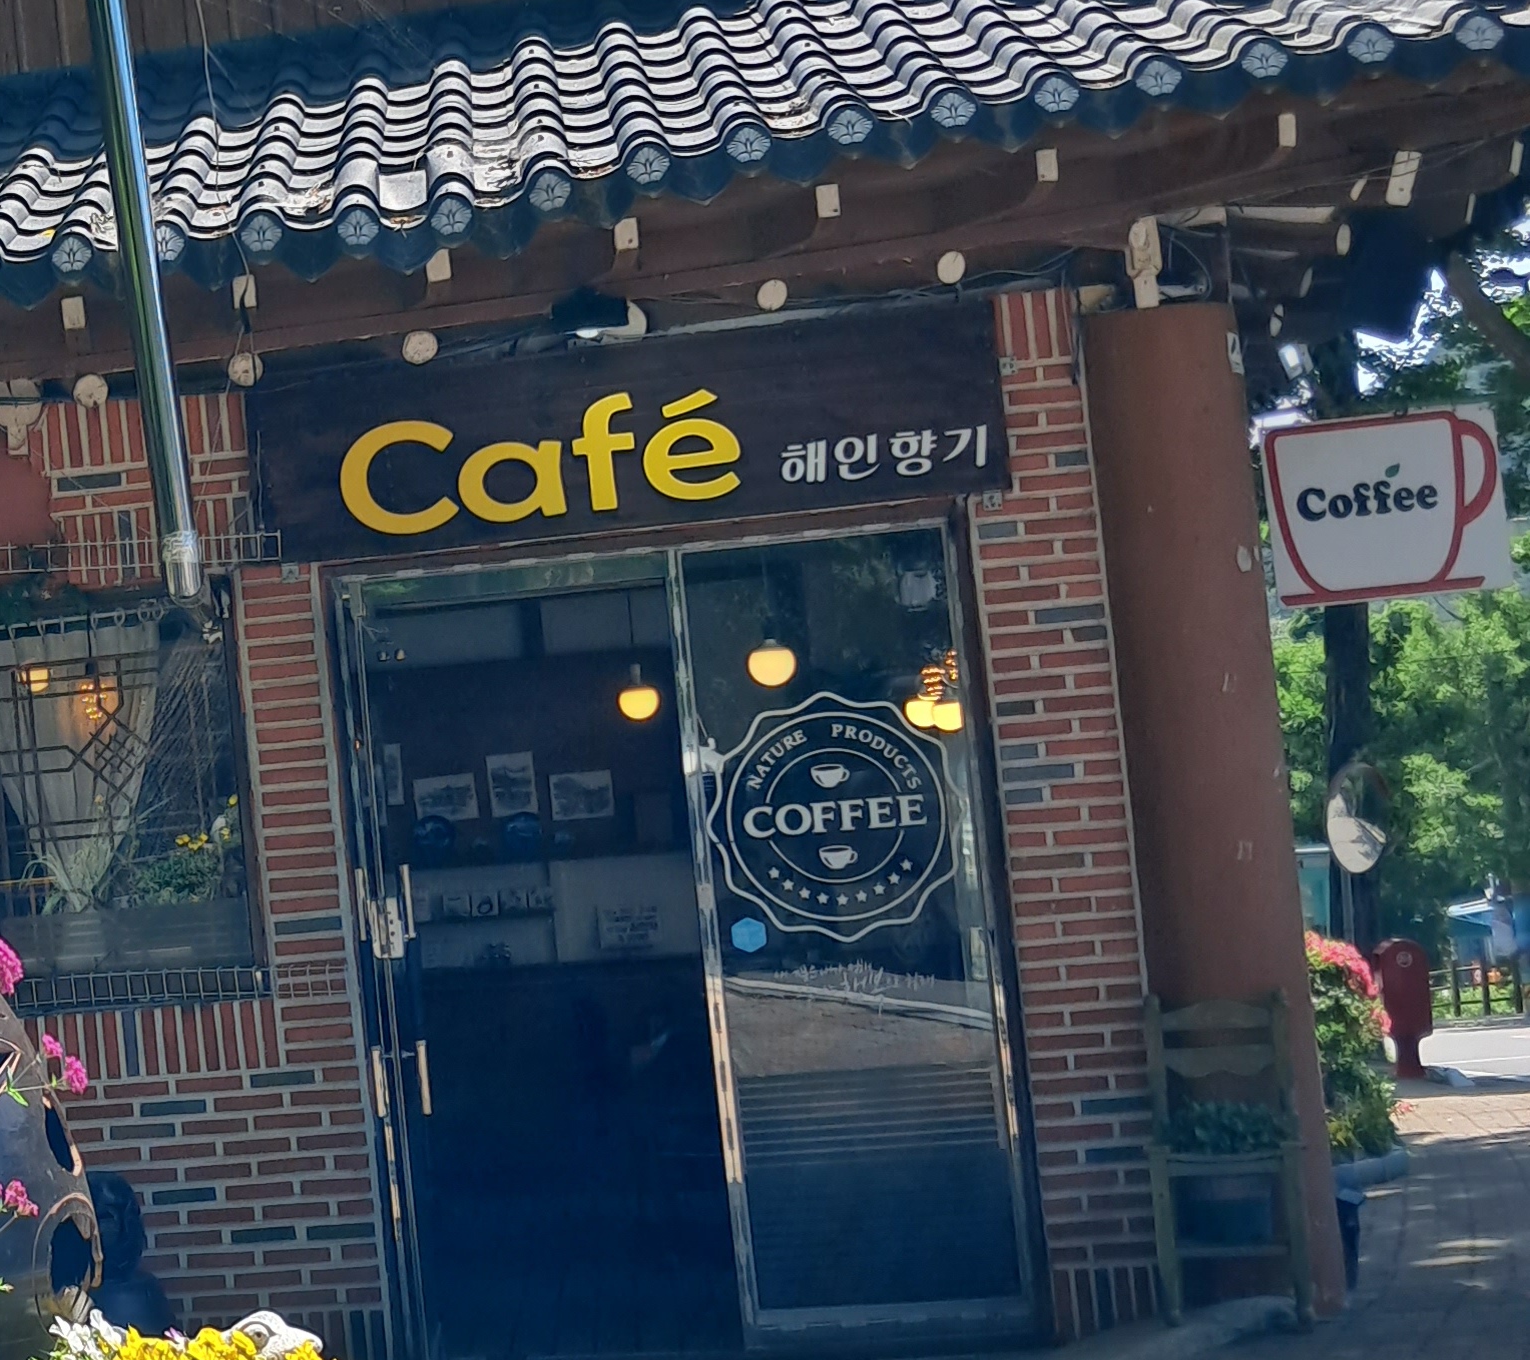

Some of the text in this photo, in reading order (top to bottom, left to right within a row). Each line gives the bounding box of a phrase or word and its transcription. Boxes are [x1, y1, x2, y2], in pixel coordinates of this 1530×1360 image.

[339, 387, 742, 536] Café
[779, 423, 989, 485] 해인향기
[1296, 480, 1439, 522] Coffee
[745, 723, 922, 790] NATURE PRODUCTS
[742, 793, 928, 839] COFFEE
